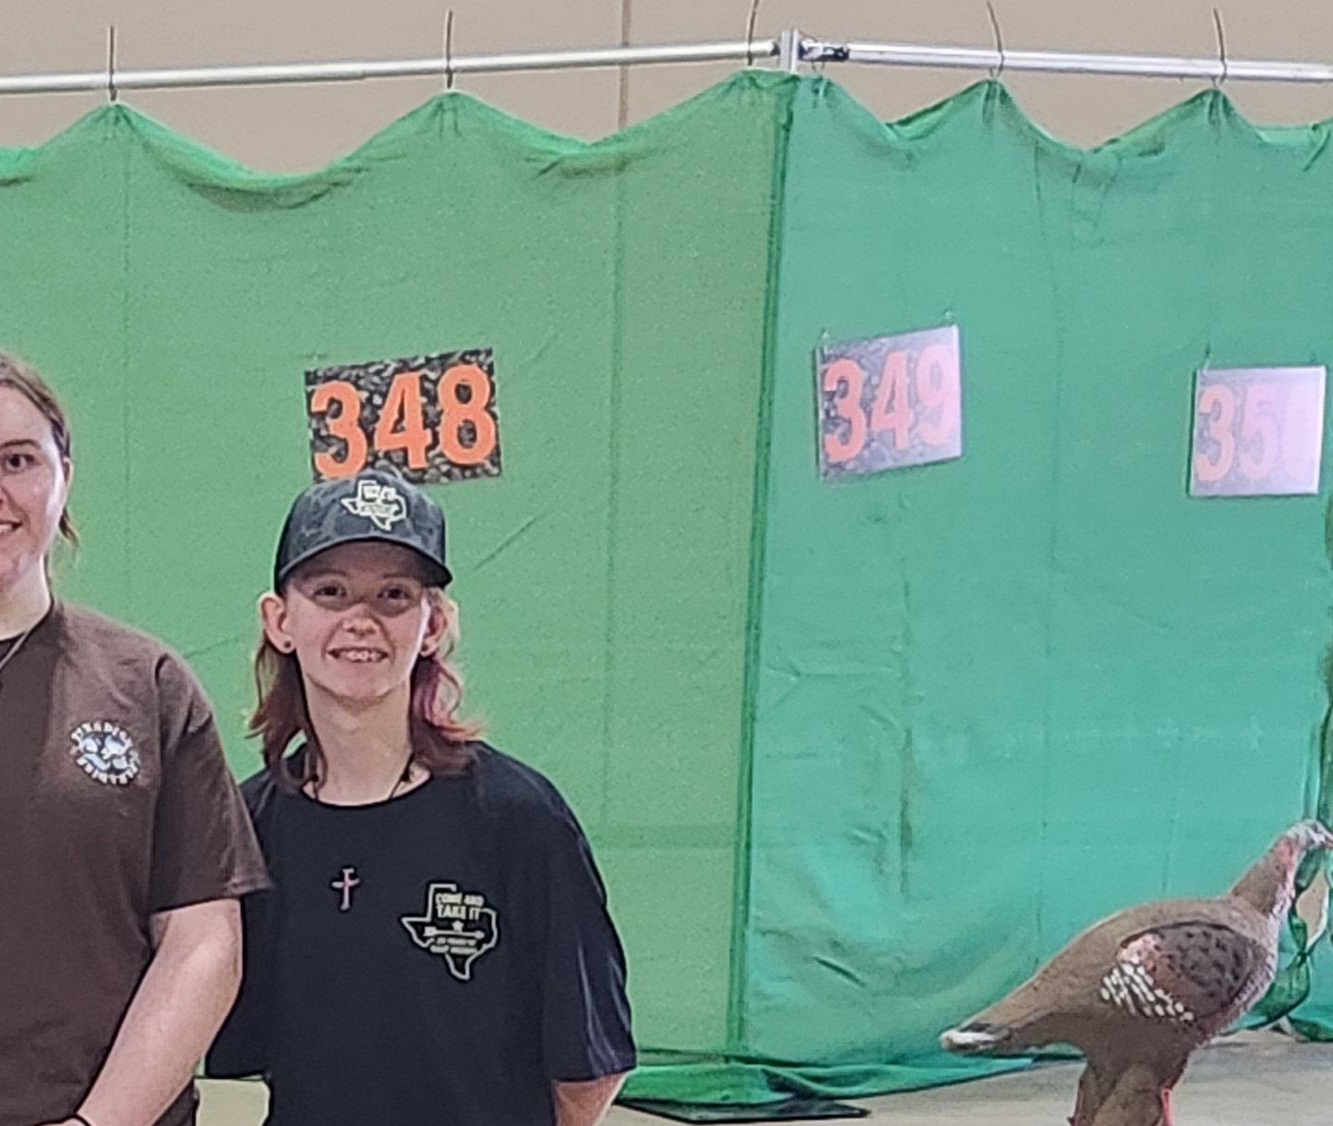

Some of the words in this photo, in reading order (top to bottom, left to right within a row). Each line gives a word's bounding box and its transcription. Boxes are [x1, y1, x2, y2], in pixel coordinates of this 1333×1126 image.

[310, 363, 496, 480] 348
[822, 343, 959, 465] 349
[436, 904, 467, 920] TAKE
